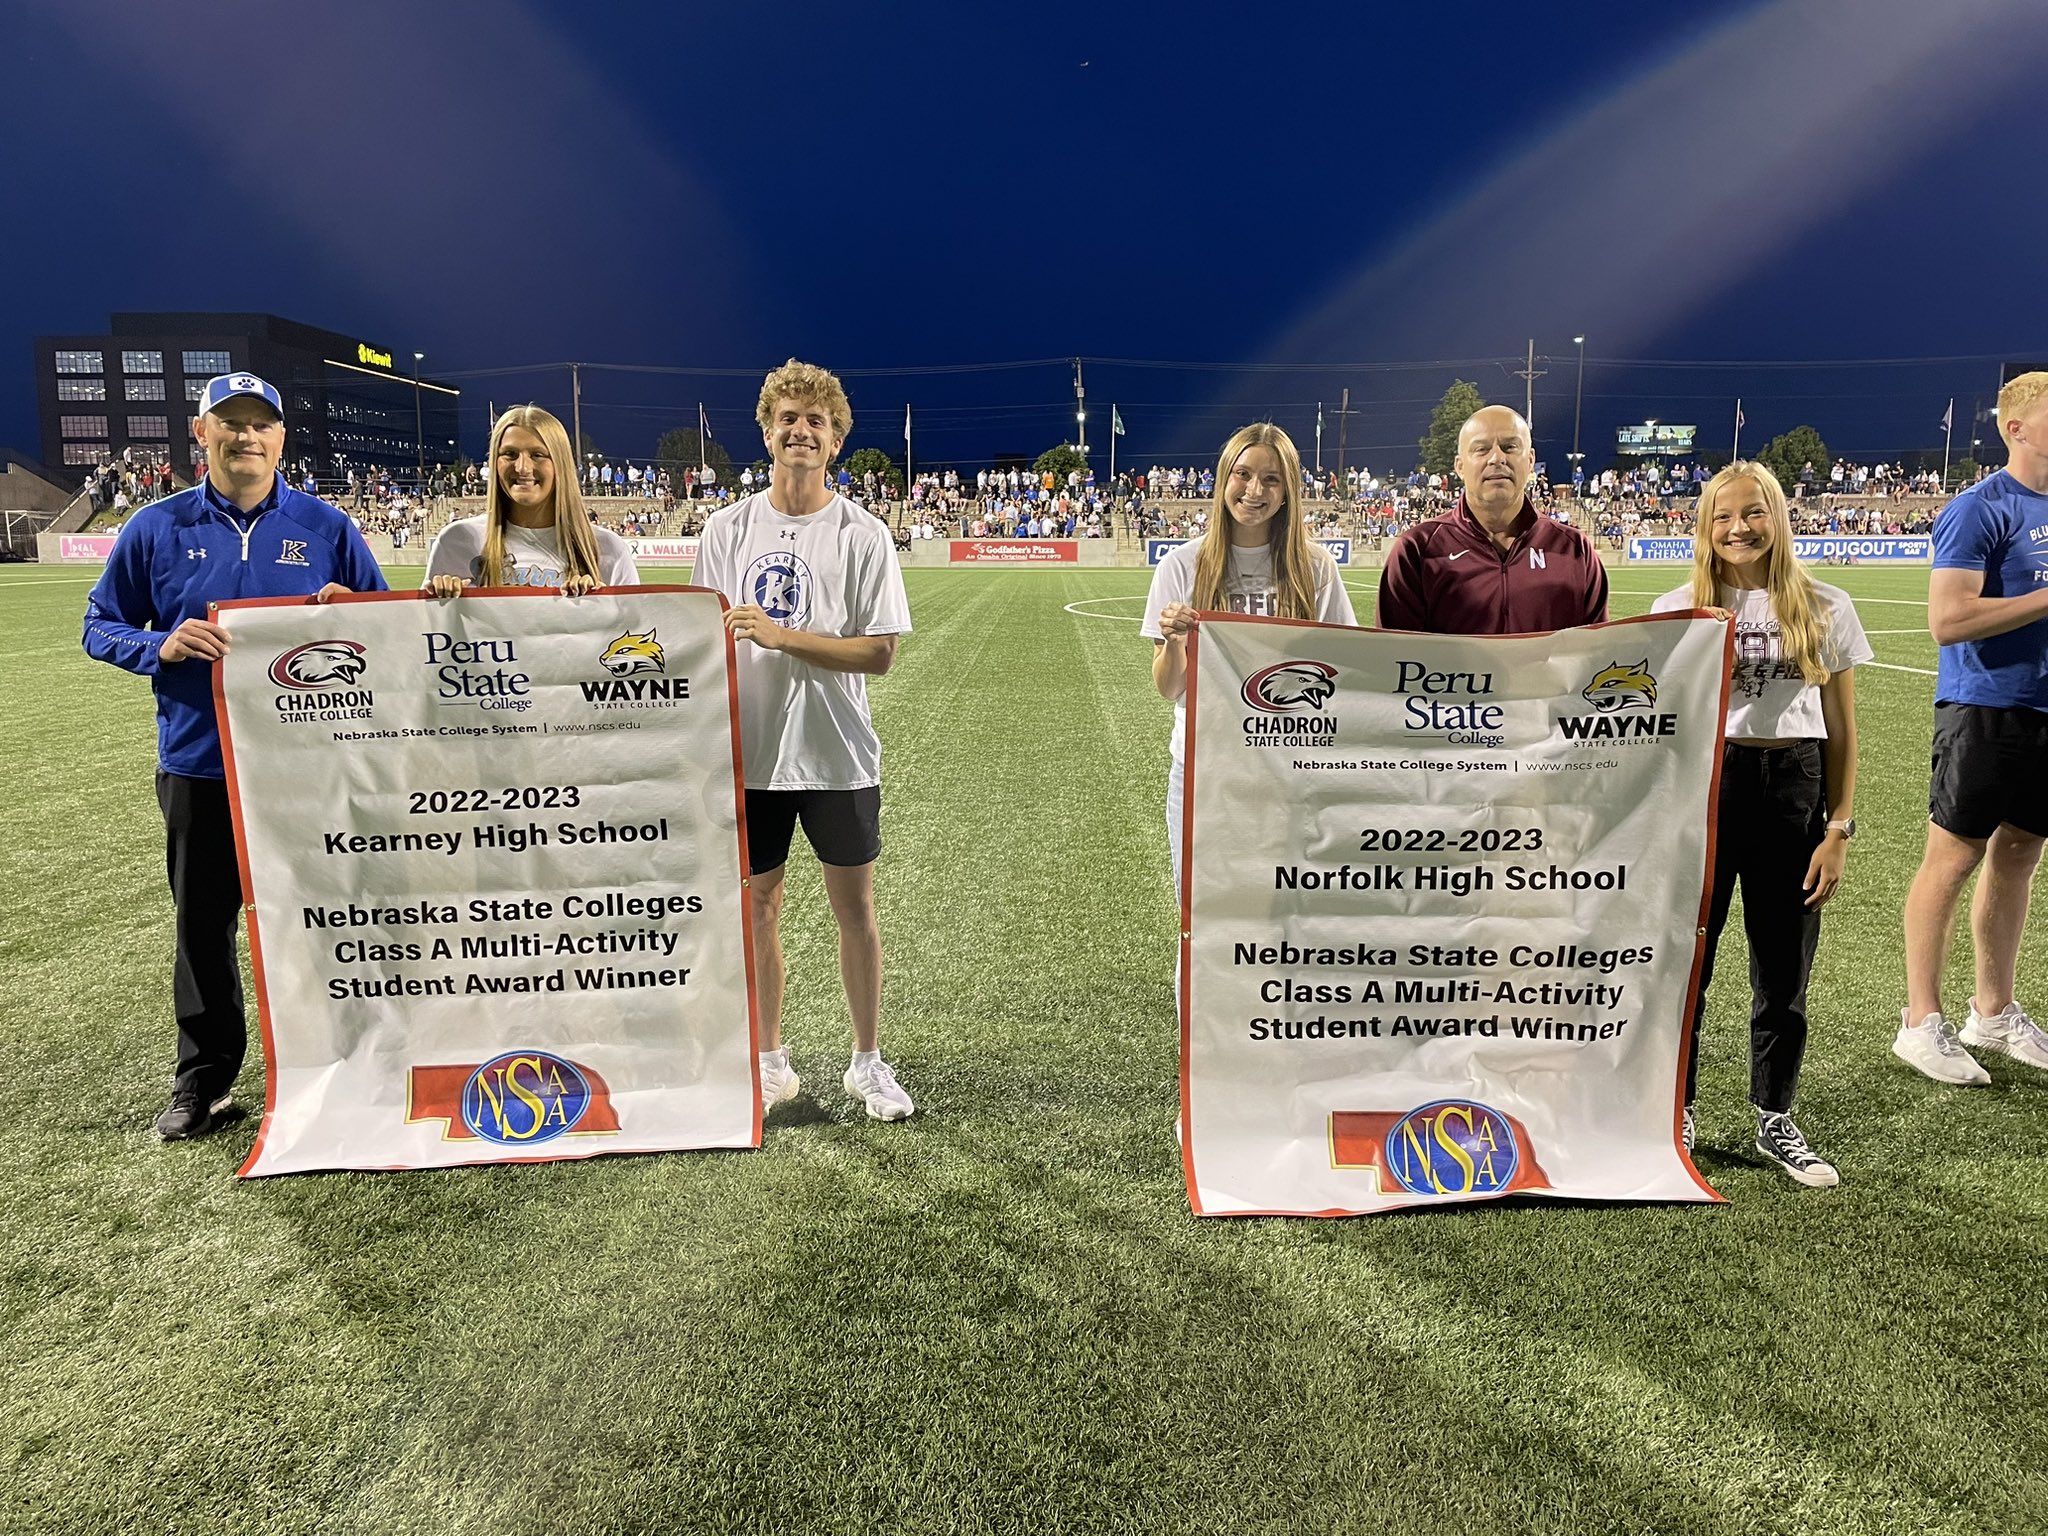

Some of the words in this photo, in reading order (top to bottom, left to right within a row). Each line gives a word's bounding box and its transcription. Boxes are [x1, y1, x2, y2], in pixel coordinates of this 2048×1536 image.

[366, 347, 392, 369] Kiewit
[281, 539, 307, 561] K
[643, 545, 650, 555] I.
[986, 545, 1031, 554] Godfather's
[1032, 545, 1055, 554] Pizza
[1650, 541, 1686, 549] OMAHA
[1823, 541, 1897, 556] DUGOUT
[1898, 541, 1927, 549] SPORTS
[756, 555, 808, 579] KEARNEY
[977, 553, 1000, 561] Omaha
[1001, 553, 1028, 561] Original
[1529, 546, 1547, 570] N
[422, 633, 517, 665] Peru
[438, 666, 531, 698] State
[1393, 661, 1493, 695] Peru
[275, 690, 374, 713] CHADRON
[580, 678, 690, 702] WAYNE
[280, 711, 317, 723] STATE
[320, 707, 373, 722] COLLEGE
[480, 698, 532, 713] College
[1405, 696, 1504, 731] State
[333, 728, 398, 741] Nebraska
[401, 726, 436, 738] State
[439, 725, 488, 738] College
[491, 724, 537, 737] System
[553, 721, 640, 732] www.nscs.edu
[1243, 716, 1337, 734] CHADRON
[1558, 714, 1677, 739] WAYNE
[1245, 736, 1281, 746] STATE
[1283, 736, 1334, 747] COLLEGE
[1448, 731, 1504, 747] College
[1574, 740, 1607, 748] STATE
[1612, 737, 1661, 746] COLLEGE
[1293, 760, 1357, 770] Nebraska
[1361, 760, 1396, 770] State
[1400, 760, 1453, 772] College
[1457, 760, 1507, 772] System
[1526, 759, 1618, 771] www.nscs.edu
[409, 787, 580, 814] 2022-2023
[324, 827, 462, 855] Kearney
[474, 825, 548, 852] High
[558, 819, 669, 844] School
[1360, 829, 1543, 852] 2022-2023
[1276, 866, 1404, 890] Norfolk
[1415, 867, 1494, 897] High
[1505, 866, 1626, 891] School
[303, 902, 458, 928] Nebraska
[469, 899, 553, 923] State
[563, 894, 703, 920] Colleges
[335, 937, 421, 963] Class
[431, 938, 452, 959] A
[461, 929, 679, 959] Multi-Activity
[1234, 942, 1397, 966] Nebraska
[1408, 945, 1499, 967] State
[1509, 944, 1654, 973] Colleges
[329, 975, 456, 999] Student
[465, 970, 564, 994] Award
[575, 966, 690, 990] Winner
[1260, 980, 1352, 1003] Class
[1362, 981, 1384, 1003] A
[1395, 981, 1624, 1010] Multi-Activity
[1249, 1017, 1381, 1041] Student
[1391, 1015, 1499, 1037] Award
[1511, 1017, 1627, 1042] Winner
